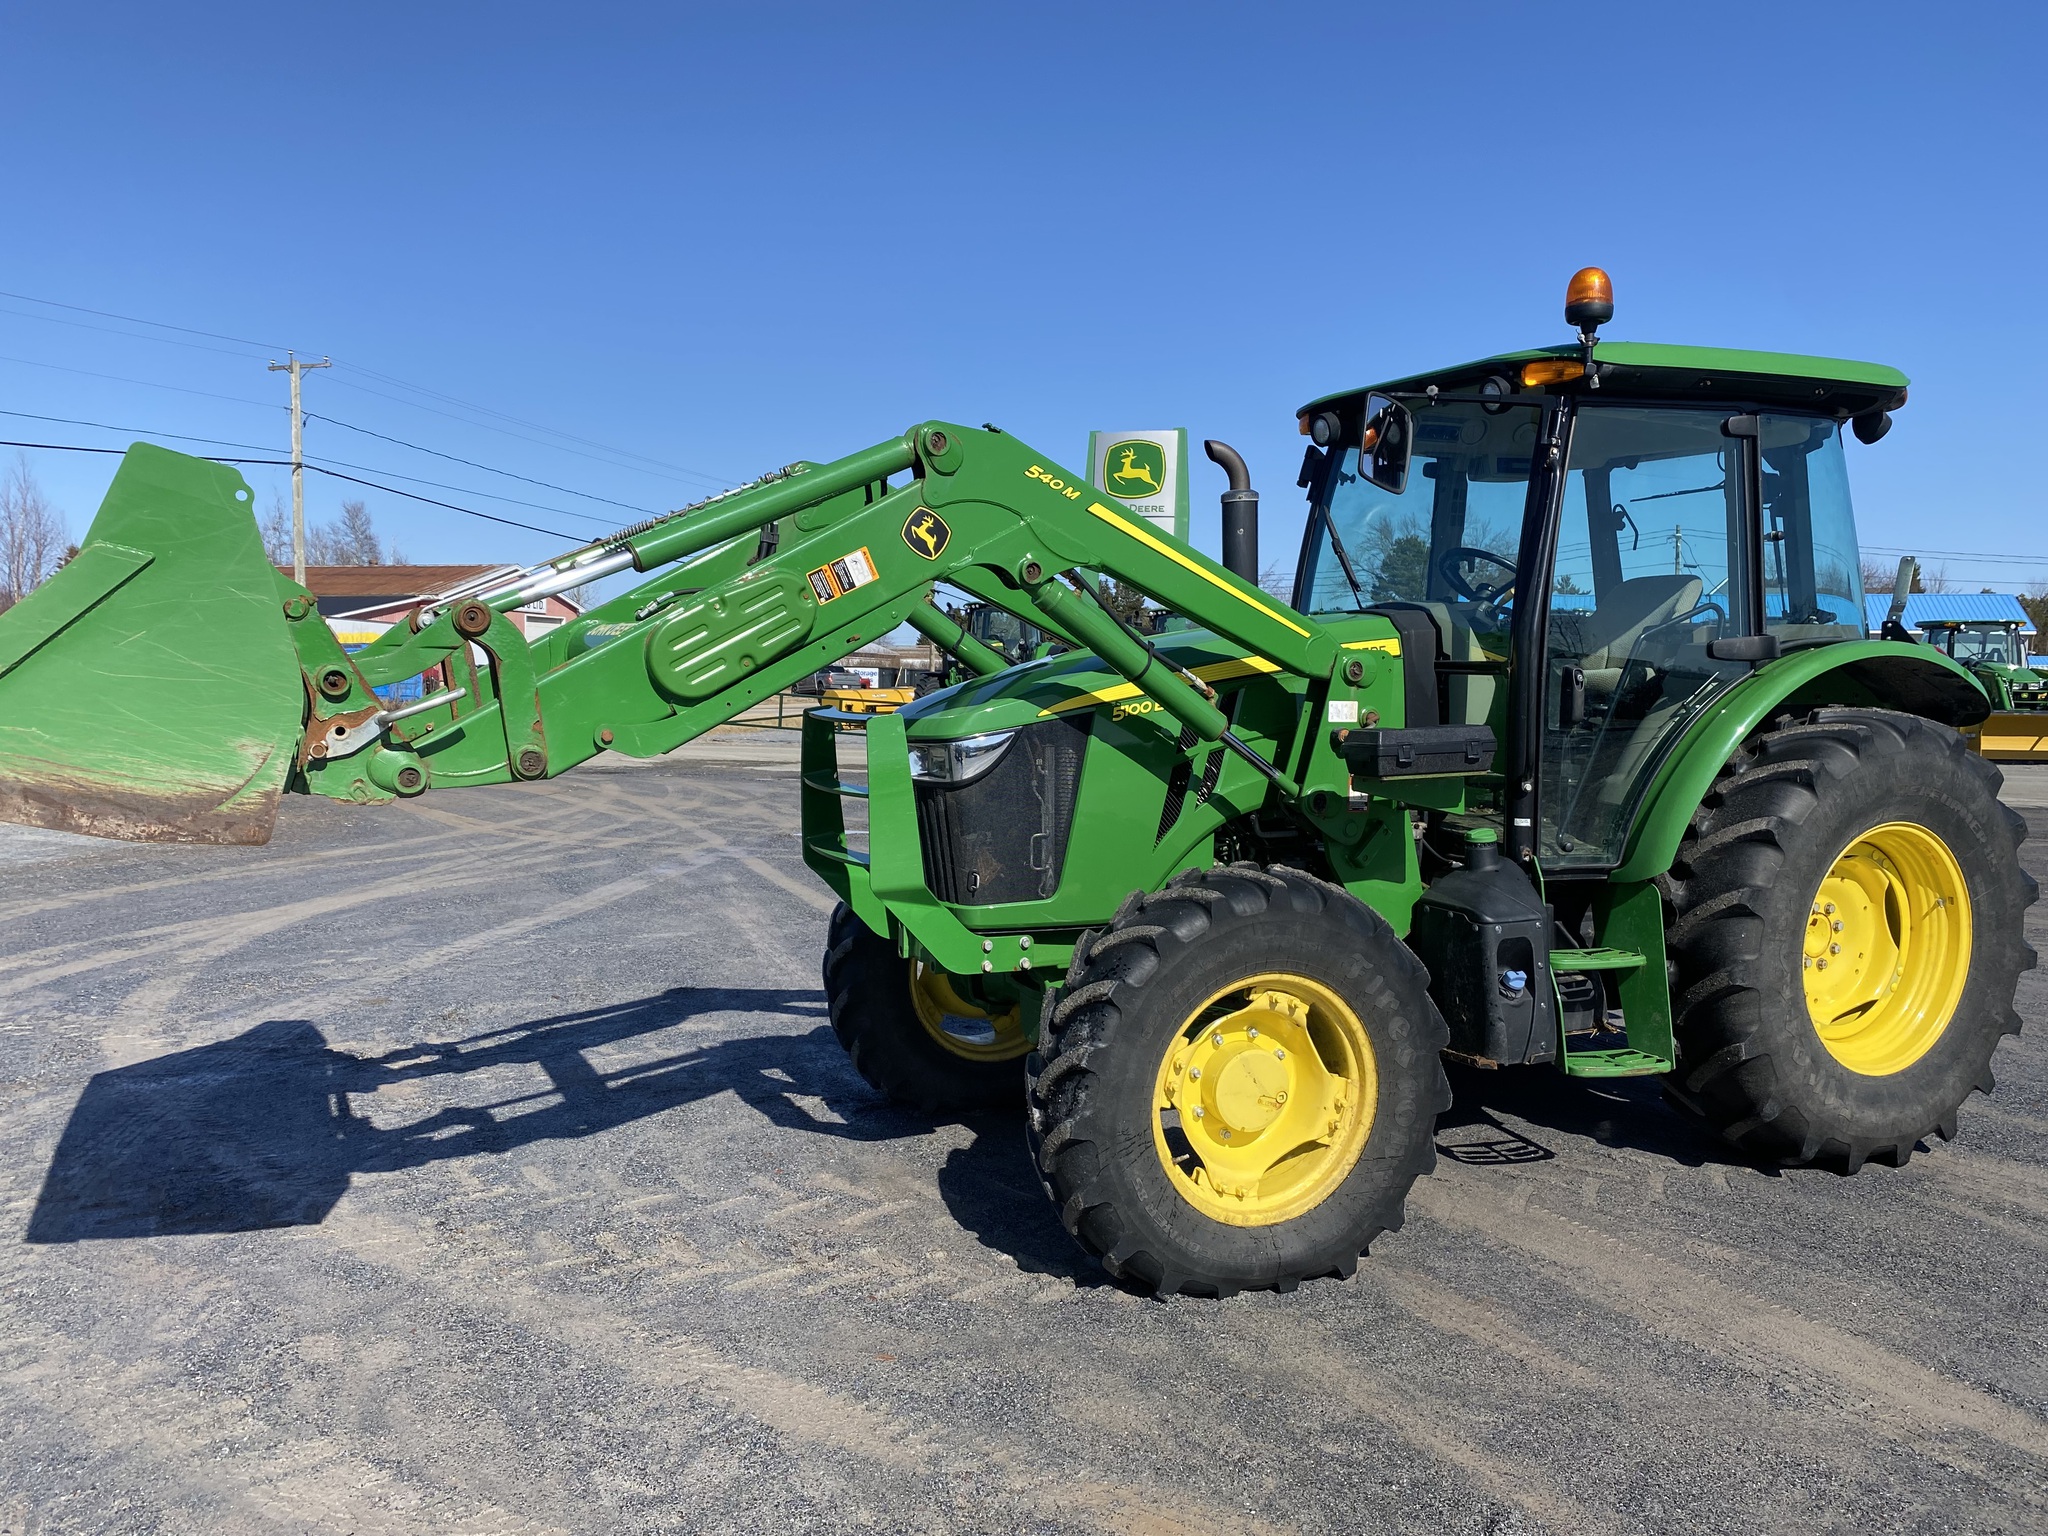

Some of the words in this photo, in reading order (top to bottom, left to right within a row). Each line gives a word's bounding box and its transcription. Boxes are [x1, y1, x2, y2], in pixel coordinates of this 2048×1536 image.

[1024, 464, 1065, 490] 540
[1061, 487, 1083, 501] M
[1129, 503, 1165, 513] DEERE
[854, 669, 878, 677] Storage
[1112, 700, 1153, 722] 5100
